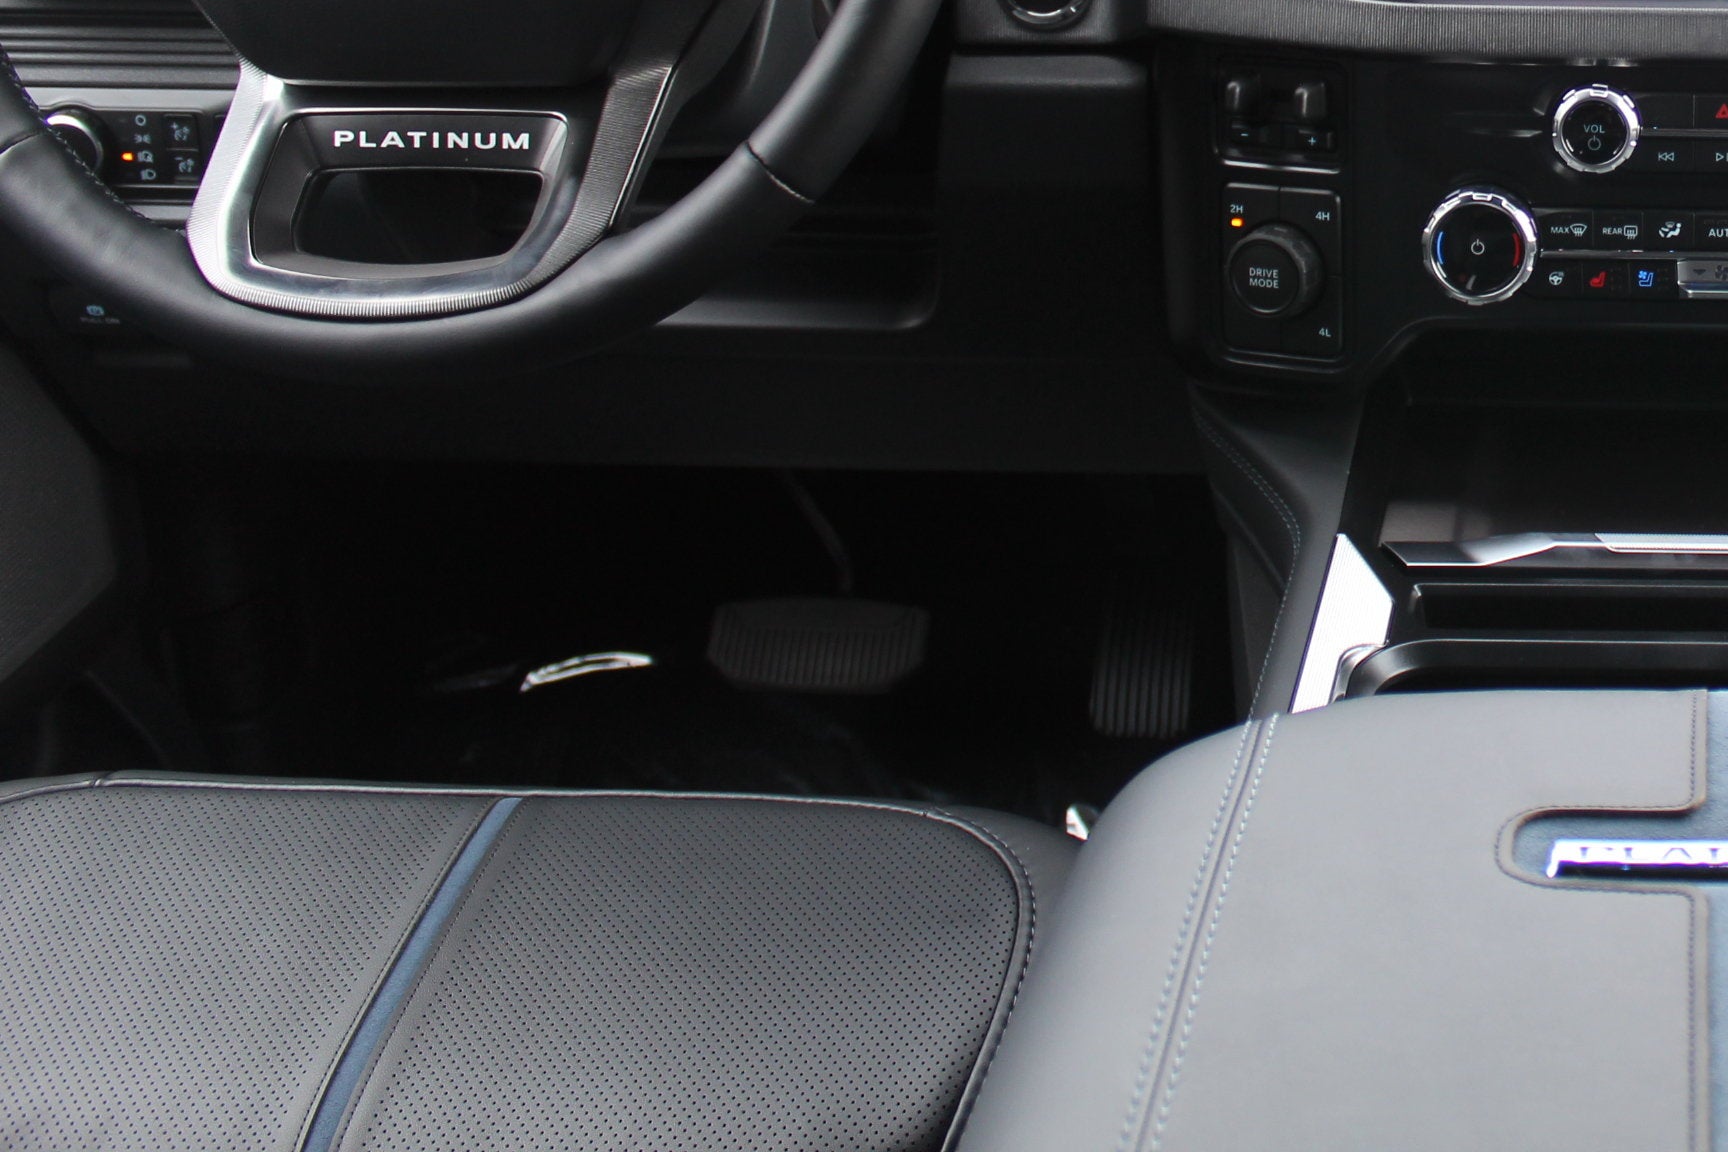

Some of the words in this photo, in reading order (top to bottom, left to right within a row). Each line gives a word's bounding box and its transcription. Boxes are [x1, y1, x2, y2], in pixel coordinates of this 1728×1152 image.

[1583, 124, 1605, 134] VOL
[333, 129, 530, 150] PLATINUM
[1229, 204, 1244, 214] 2H
[1315, 211, 1331, 222] 4H
[1550, 225, 1570, 235] MAX
[1602, 226, 1623, 236] REAR
[1249, 267, 1279, 279] DRIVE
[1249, 277, 1280, 289] MODE
[1318, 327, 1332, 338] 4L
